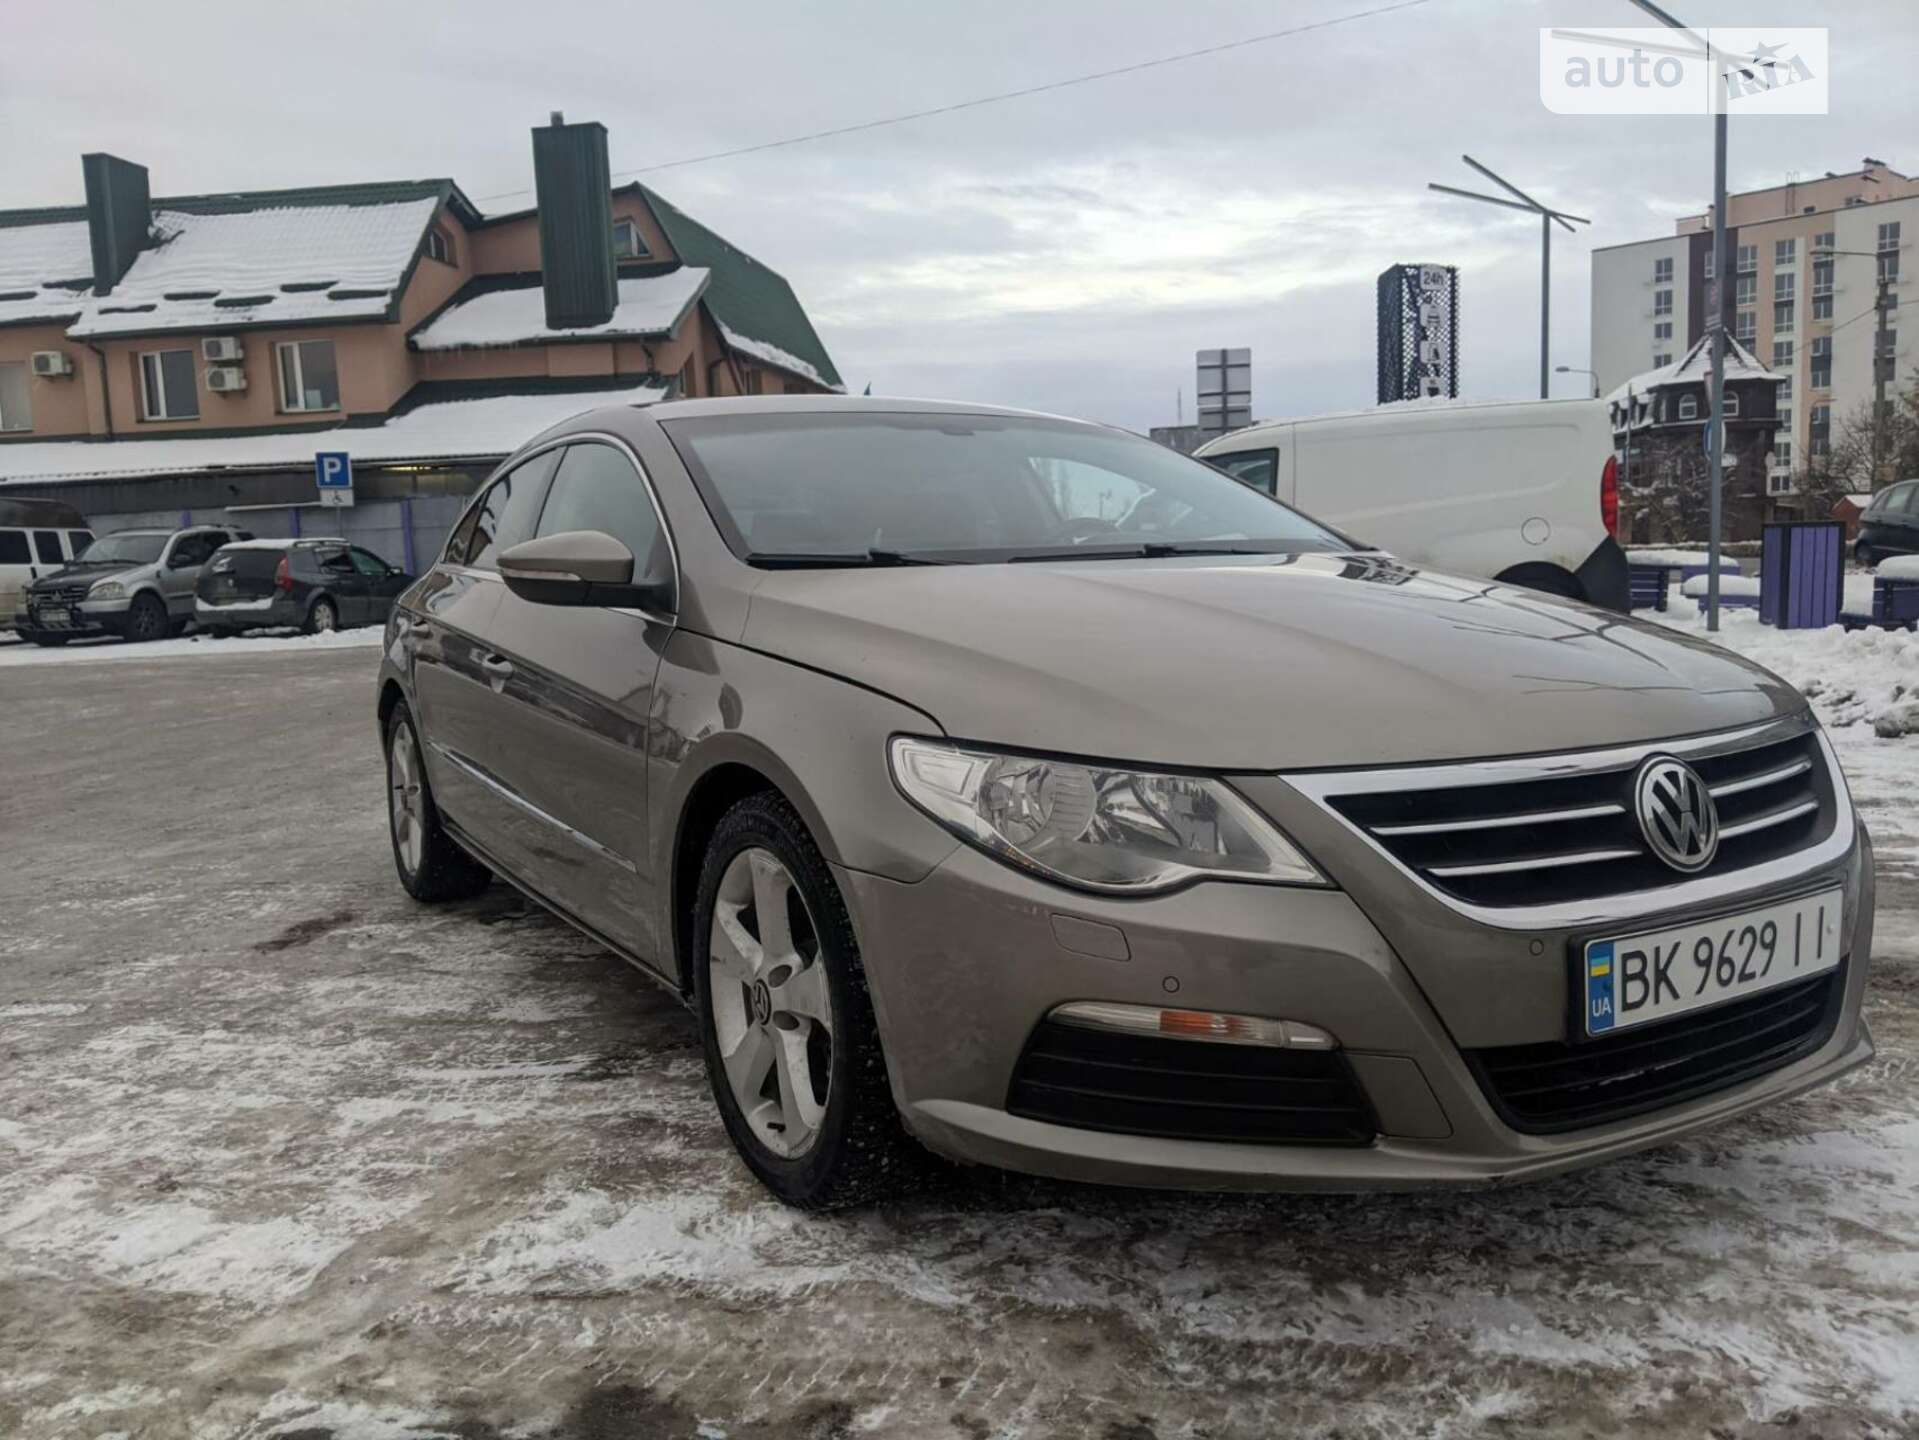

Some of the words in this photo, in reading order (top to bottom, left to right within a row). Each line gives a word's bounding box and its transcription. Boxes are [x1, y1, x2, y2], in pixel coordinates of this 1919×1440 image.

[323, 457, 342, 483] P
[1640, 760, 1714, 868] VW
[1621, 941, 1682, 1012] BK
[1693, 920, 1777, 995] 9629
[1592, 996, 1612, 1017] UA
